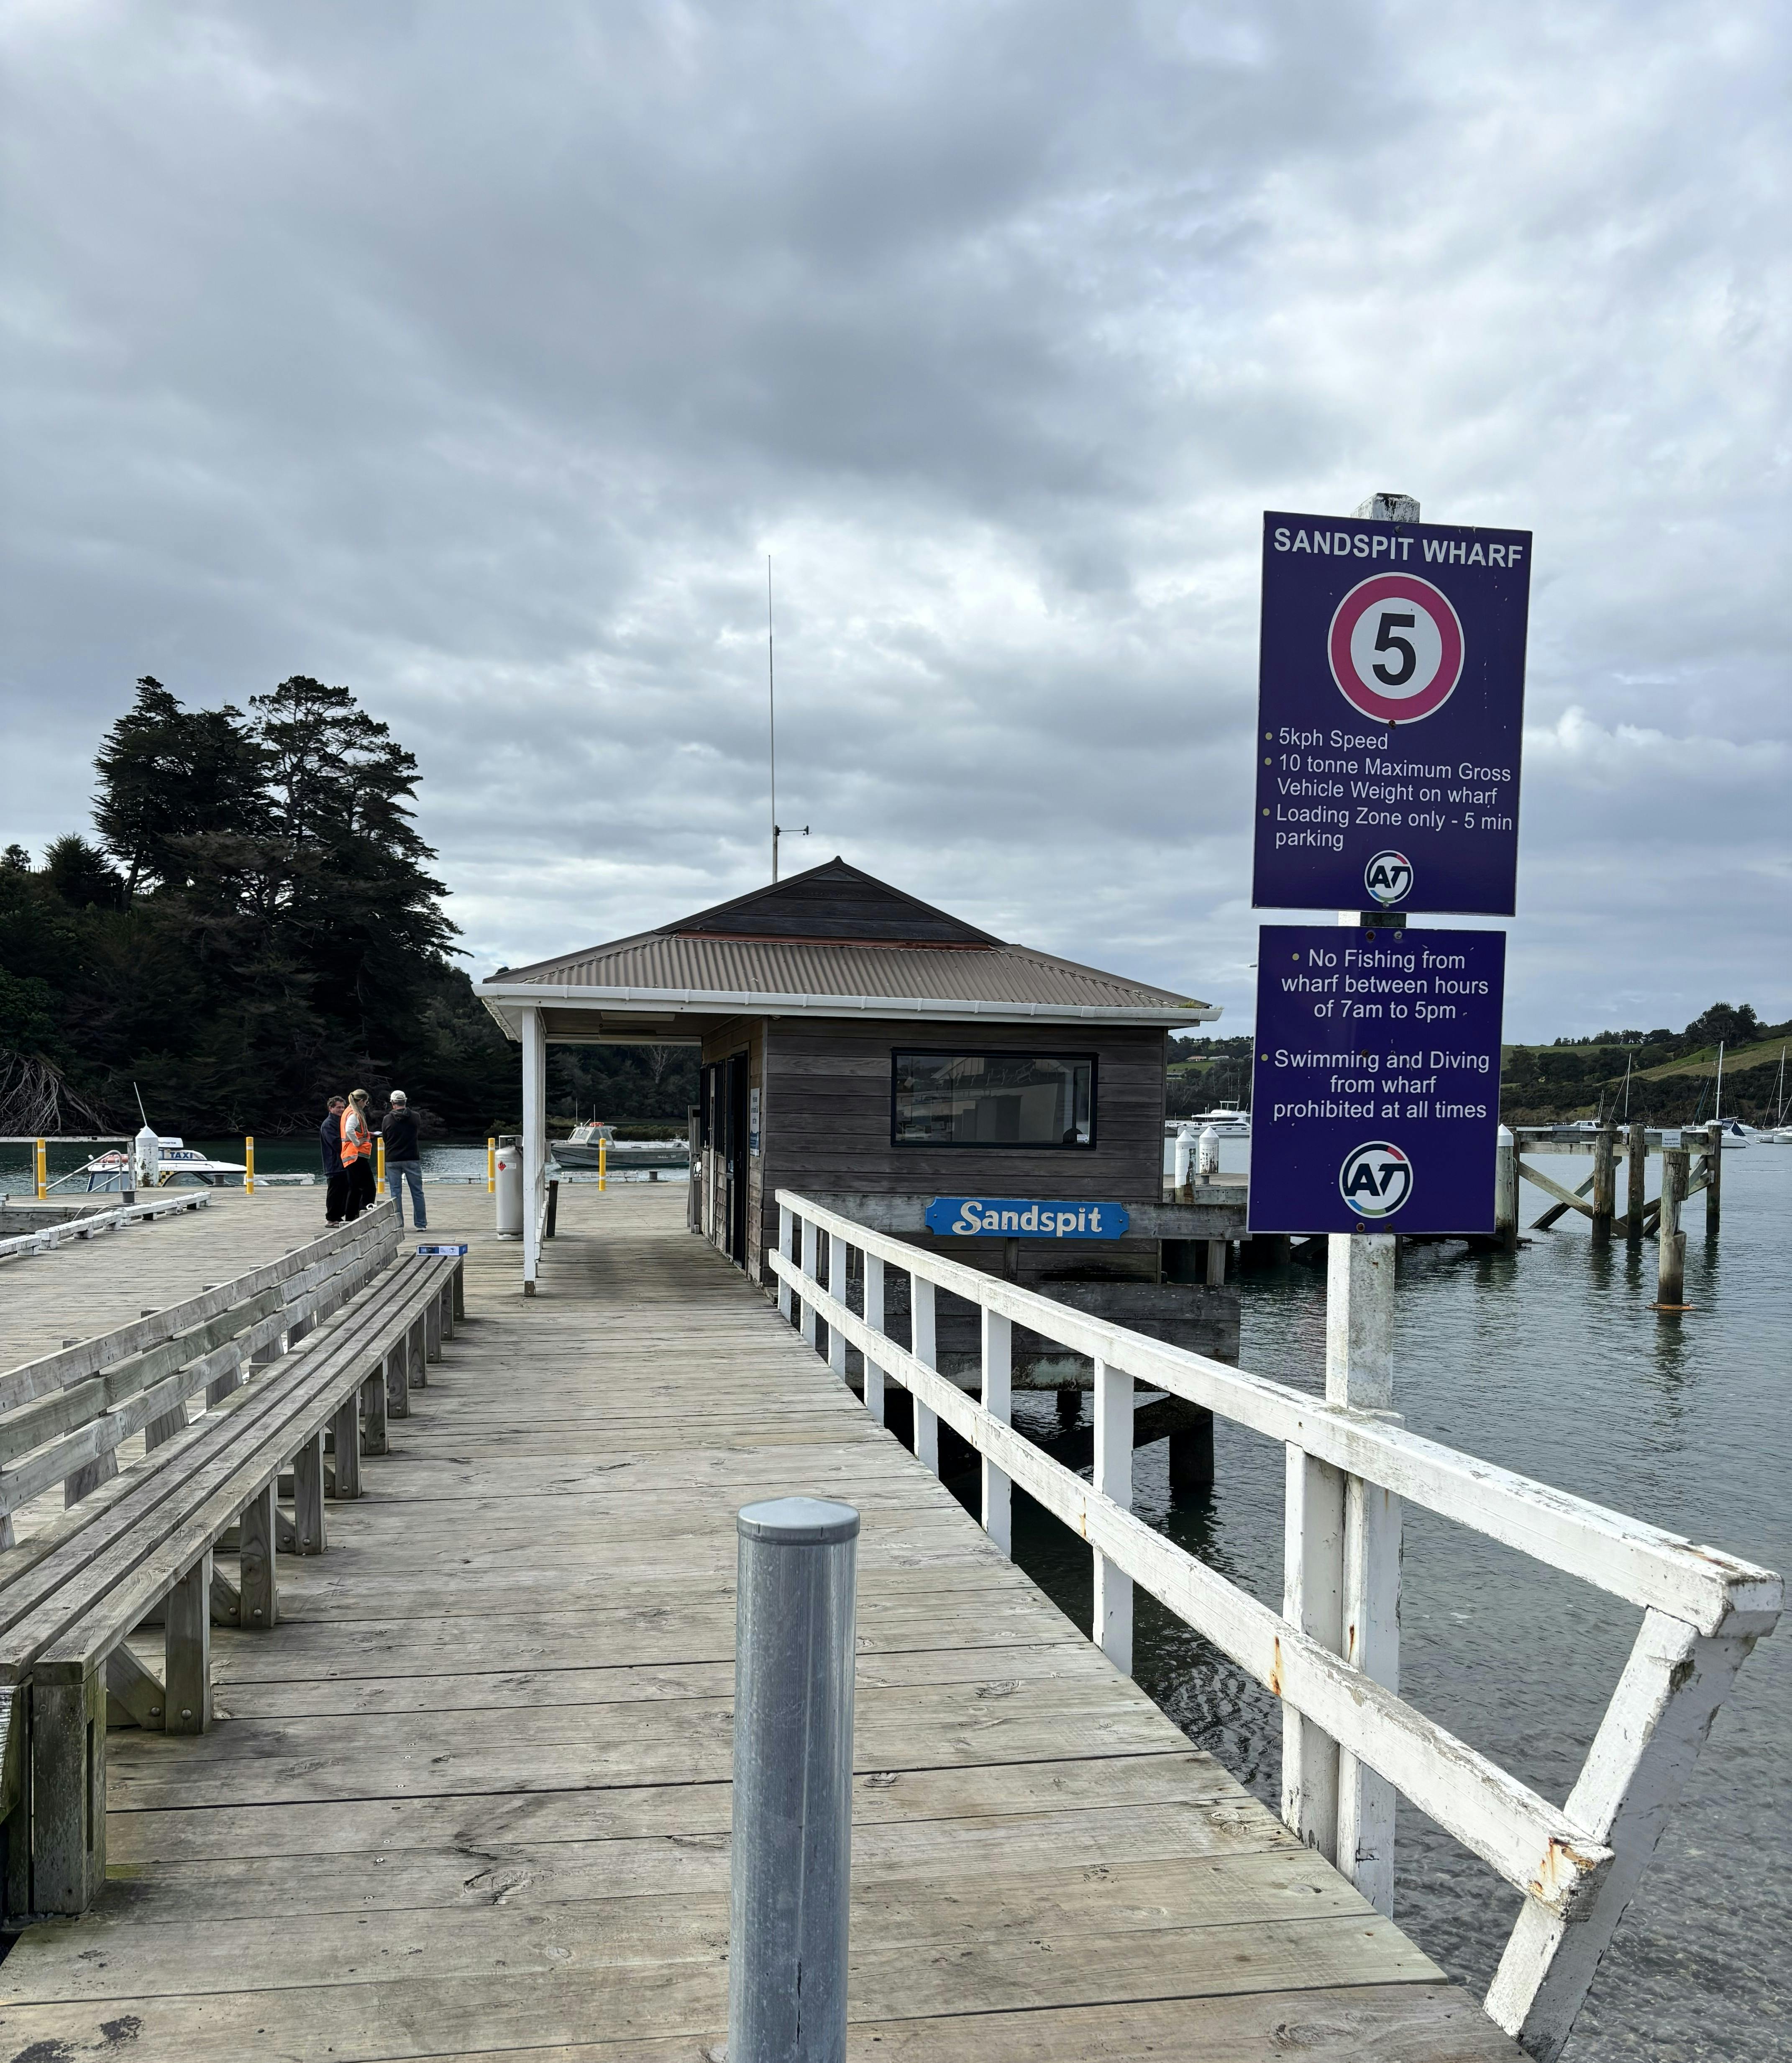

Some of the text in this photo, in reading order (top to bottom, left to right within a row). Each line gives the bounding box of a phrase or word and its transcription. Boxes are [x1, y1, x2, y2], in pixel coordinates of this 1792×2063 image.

[1274, 528, 1523, 567] SANDSPIT WHARF
[1372, 612, 1416, 686] 5
[1279, 728, 1388, 751] 5kph Speed
[1280, 753, 1511, 782] 10 tonne Maximum Gross
[1277, 777, 1498, 804] Vehicle Weight on wharf
[1277, 804, 1349, 828] Loading
[1356, 807, 1402, 826] Zone
[1408, 810, 1446, 831] only
[1464, 812, 1475, 828] 5
[1482, 813, 1512, 830] min
[1275, 829, 1344, 851] parking
[1367, 865, 1411, 889] AT
[1309, 949, 1465, 973] No Fishing from
[1281, 974, 1488, 994] wharf between hours
[1314, 999, 1456, 1023] of 7am to 5pm
[1275, 1049, 1489, 1073] Swimming and Diving
[1330, 1075, 1437, 1093] from wharf
[1274, 1100, 1487, 1121] prohibited at all times
[1342, 1163, 1410, 1197] AT
[952, 1201, 1102, 1237] Sandspit
